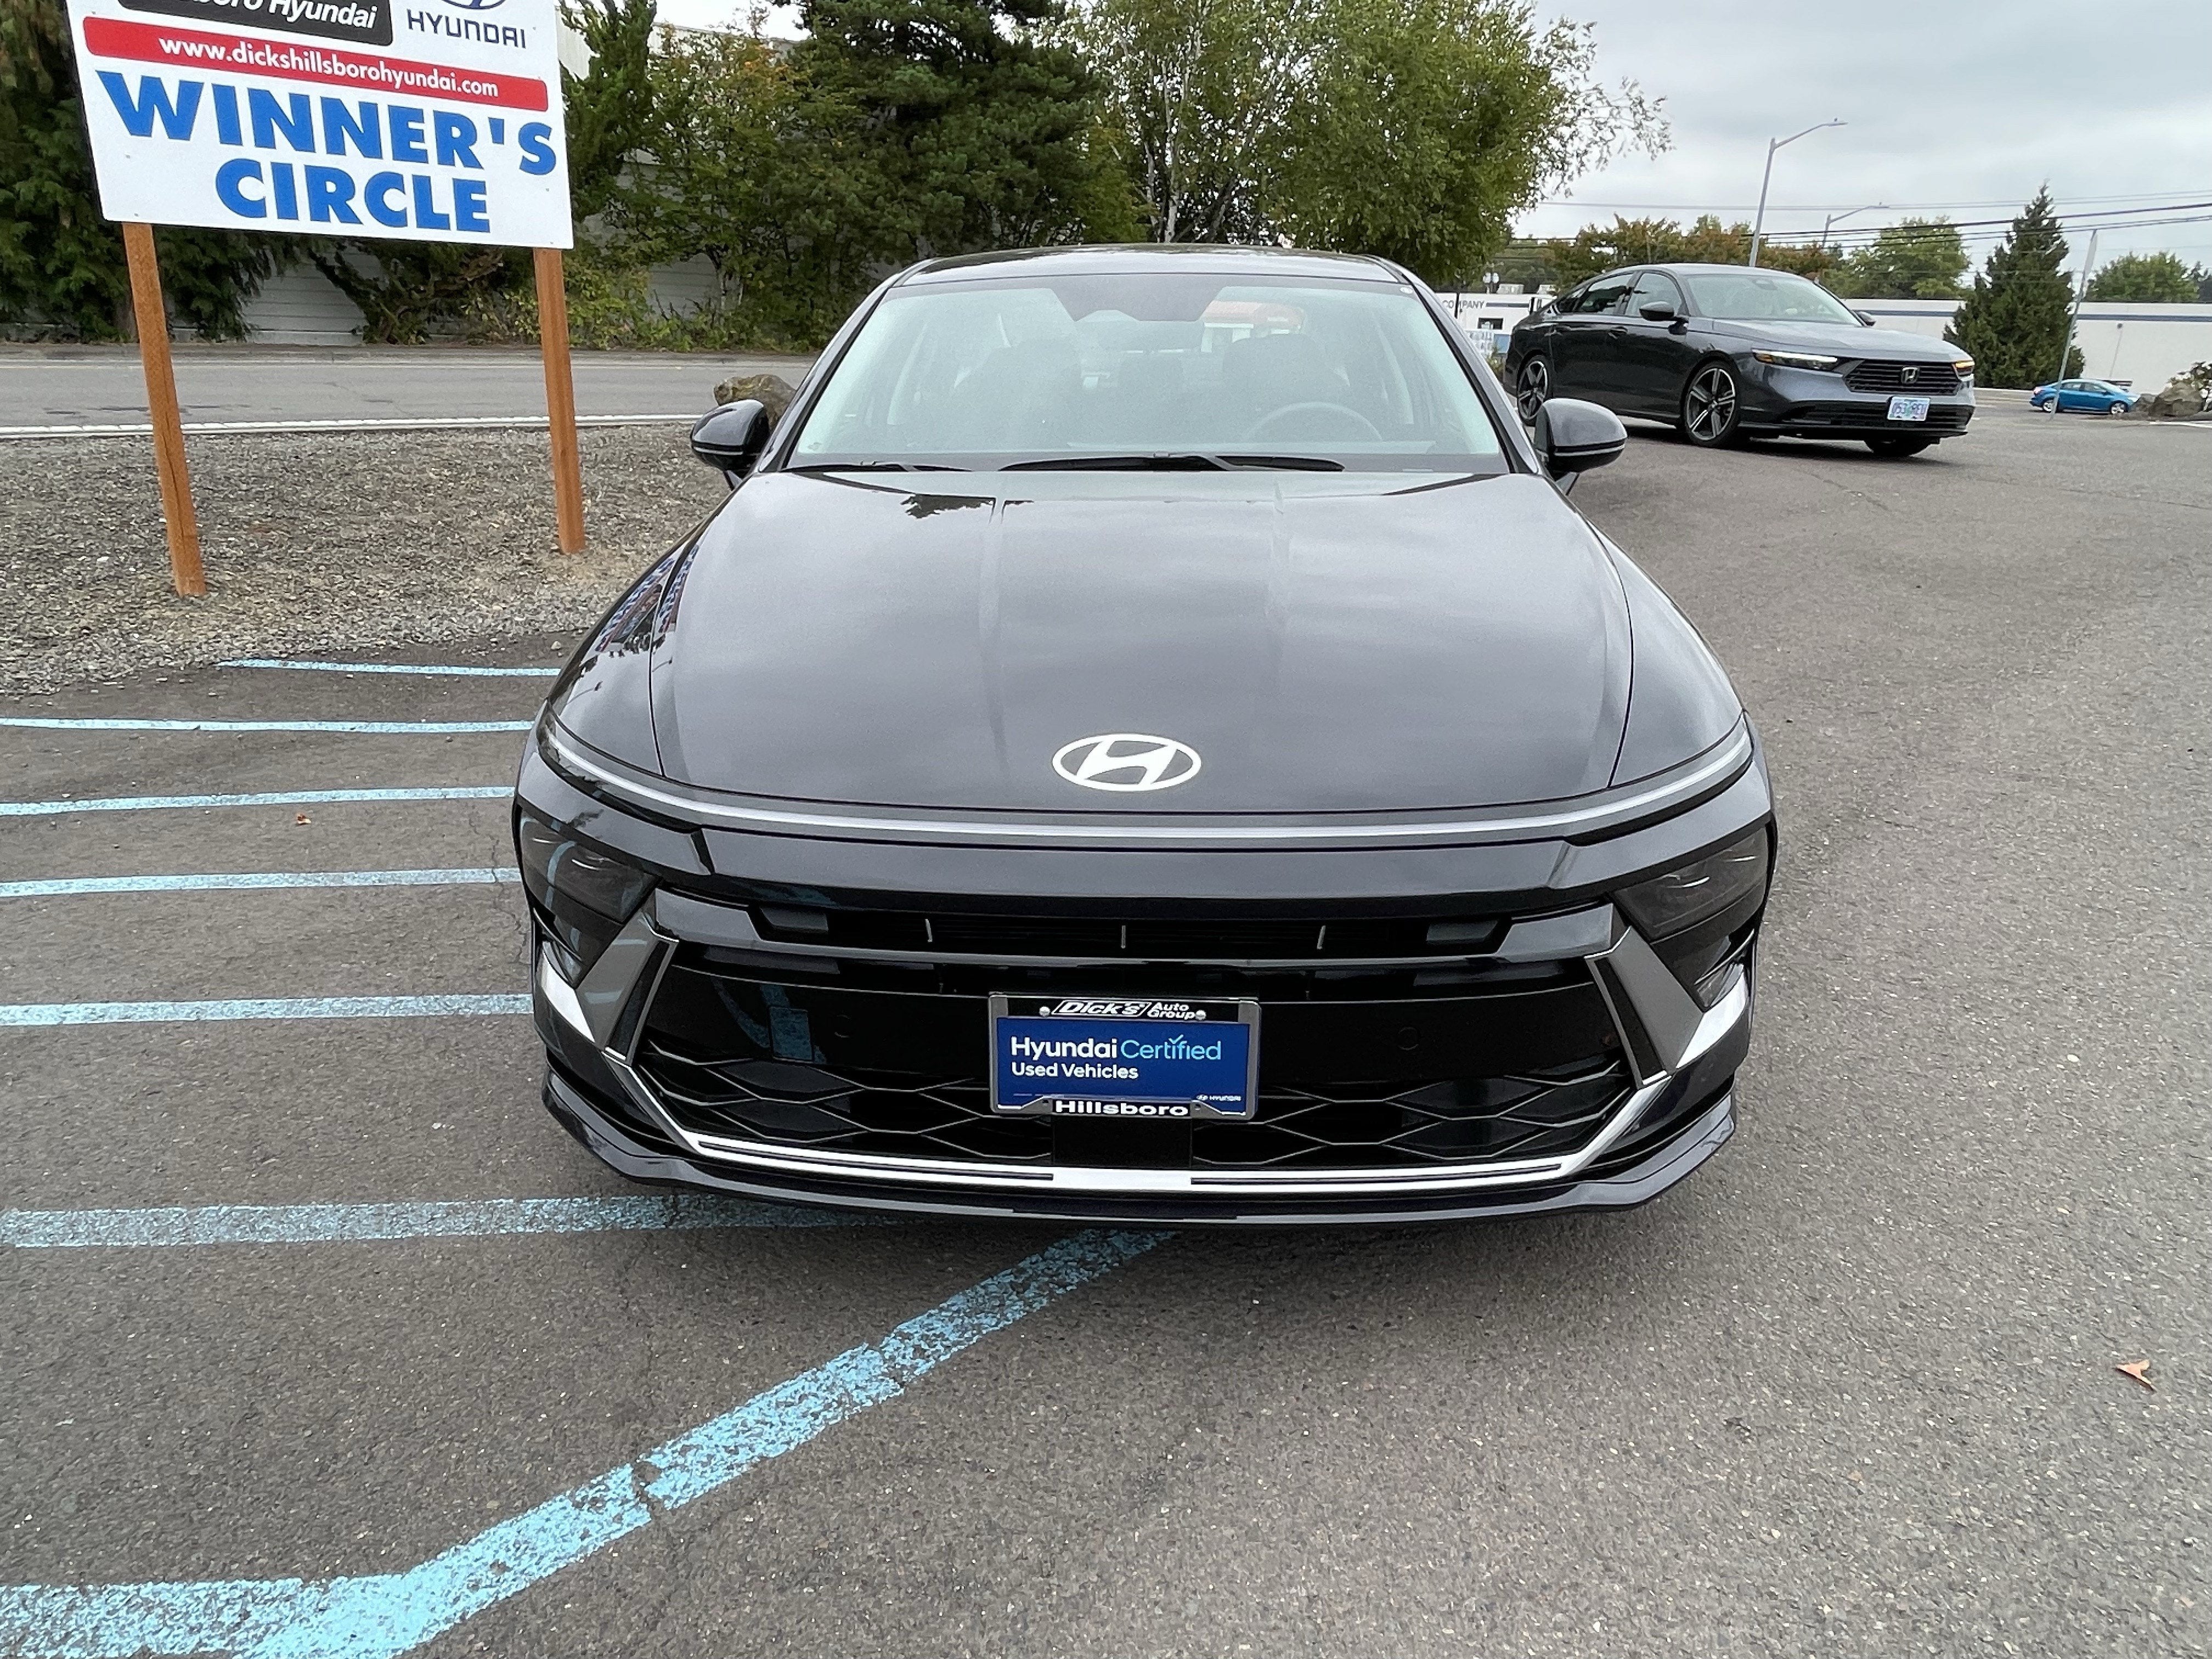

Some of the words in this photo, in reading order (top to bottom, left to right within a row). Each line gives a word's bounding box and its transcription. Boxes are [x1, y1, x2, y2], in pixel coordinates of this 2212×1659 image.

[269, 0, 377, 29] Hyundai
[407, 8, 527, 49] HYUNDAI
[159, 37, 499, 97] www.dickshillsborohyundai.com
[95, 70, 556, 175] WINNER'S
[216, 158, 490, 234] CIRCLE
[1442, 300, 1485, 309] COPANY
[1147, 1009, 1195, 1020] Group
[1153, 1002, 1189, 1011] Auto
[1011, 1036, 1117, 1060] Hyundai
[1121, 1034, 1221, 1060] Certified
[1012, 1063, 1058, 1077] Used
[1061, 1063, 1139, 1079] Vehicles
[1055, 1100, 1188, 1116] Hillsboro
